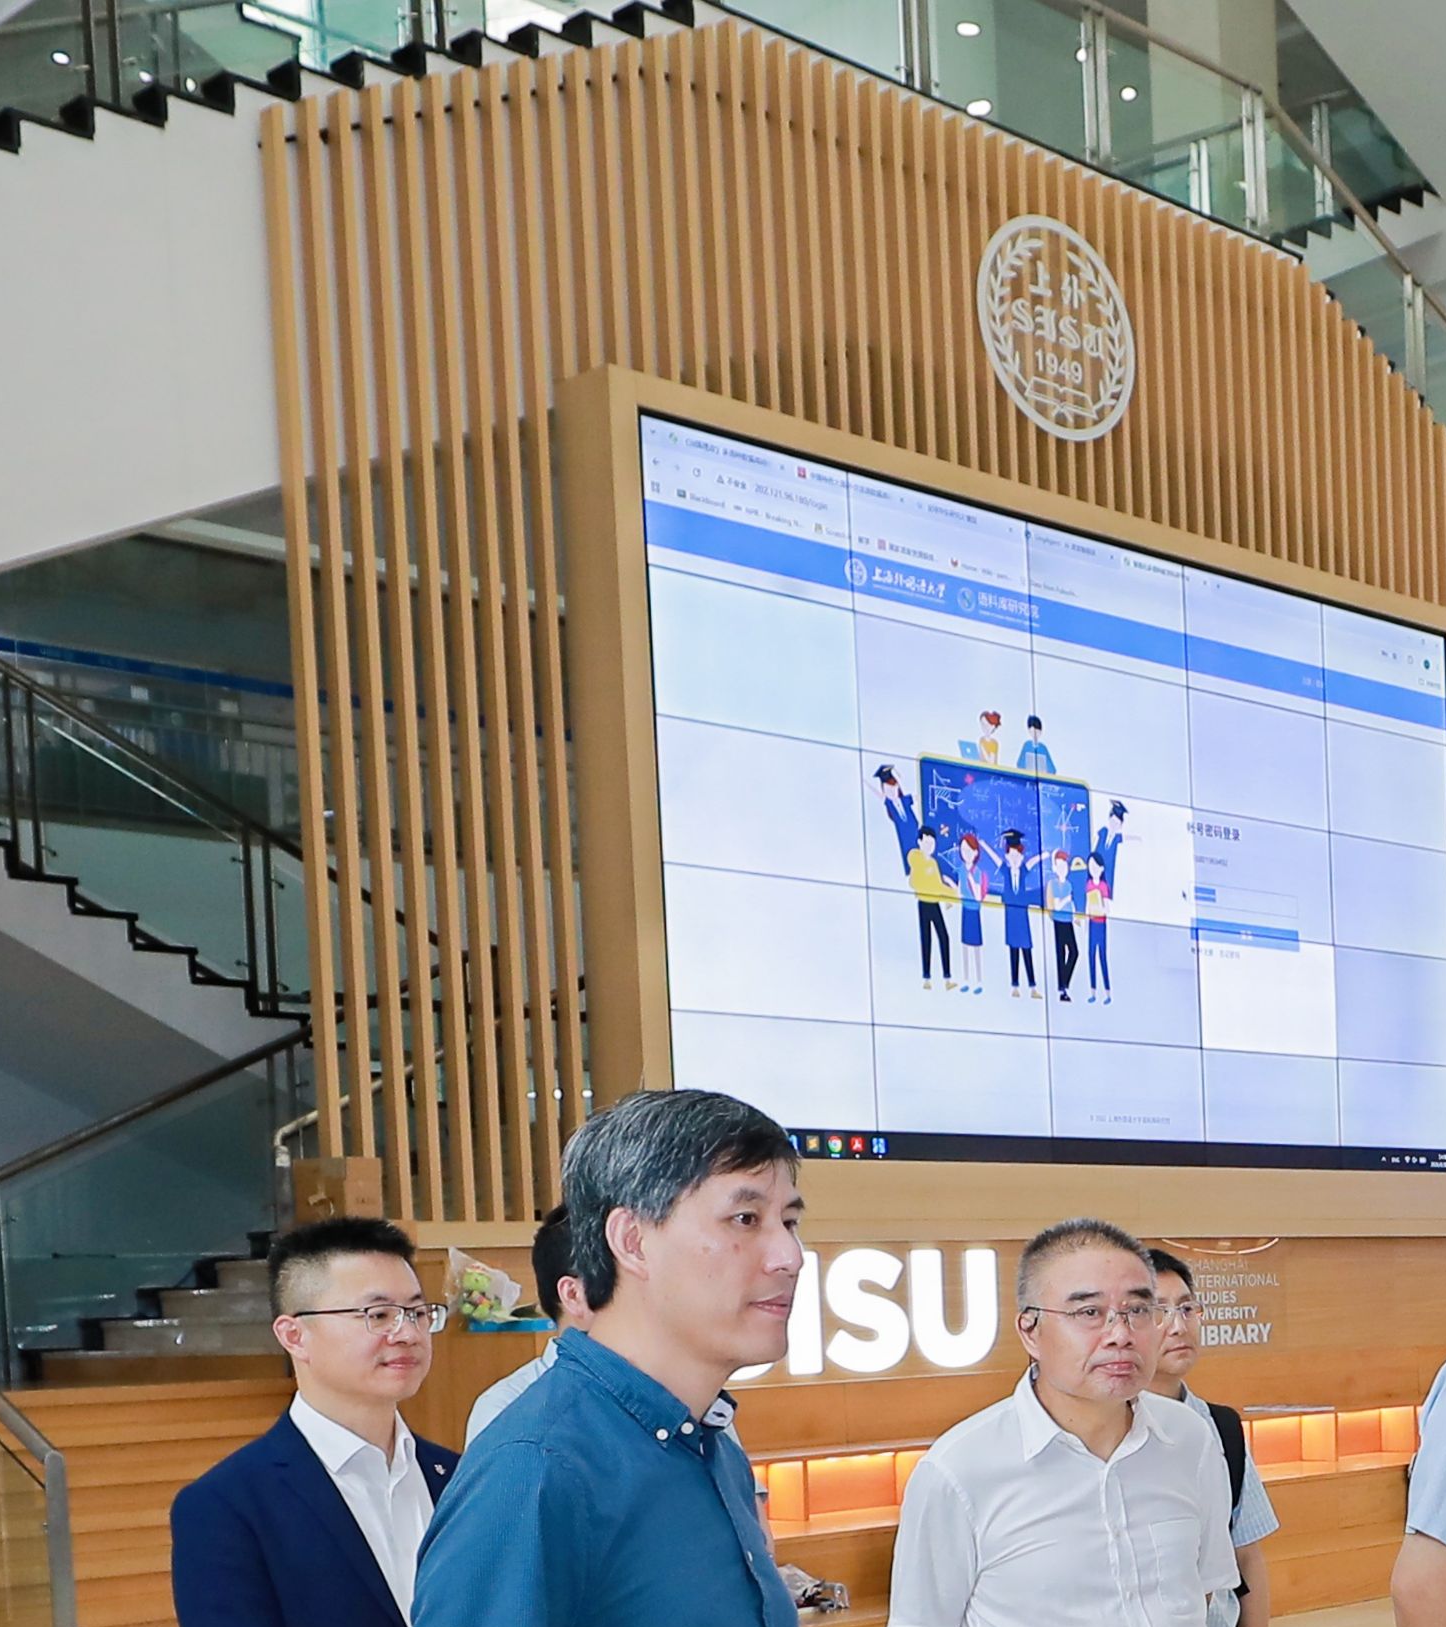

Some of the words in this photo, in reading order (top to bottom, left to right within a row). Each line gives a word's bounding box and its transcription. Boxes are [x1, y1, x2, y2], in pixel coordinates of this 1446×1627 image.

[1035, 349, 1083, 384] 1949
[1195, 1291, 1237, 1305] TUDIES
[728, 1248, 999, 1381] ISU
[1201, 1322, 1272, 1346] IBRARY
